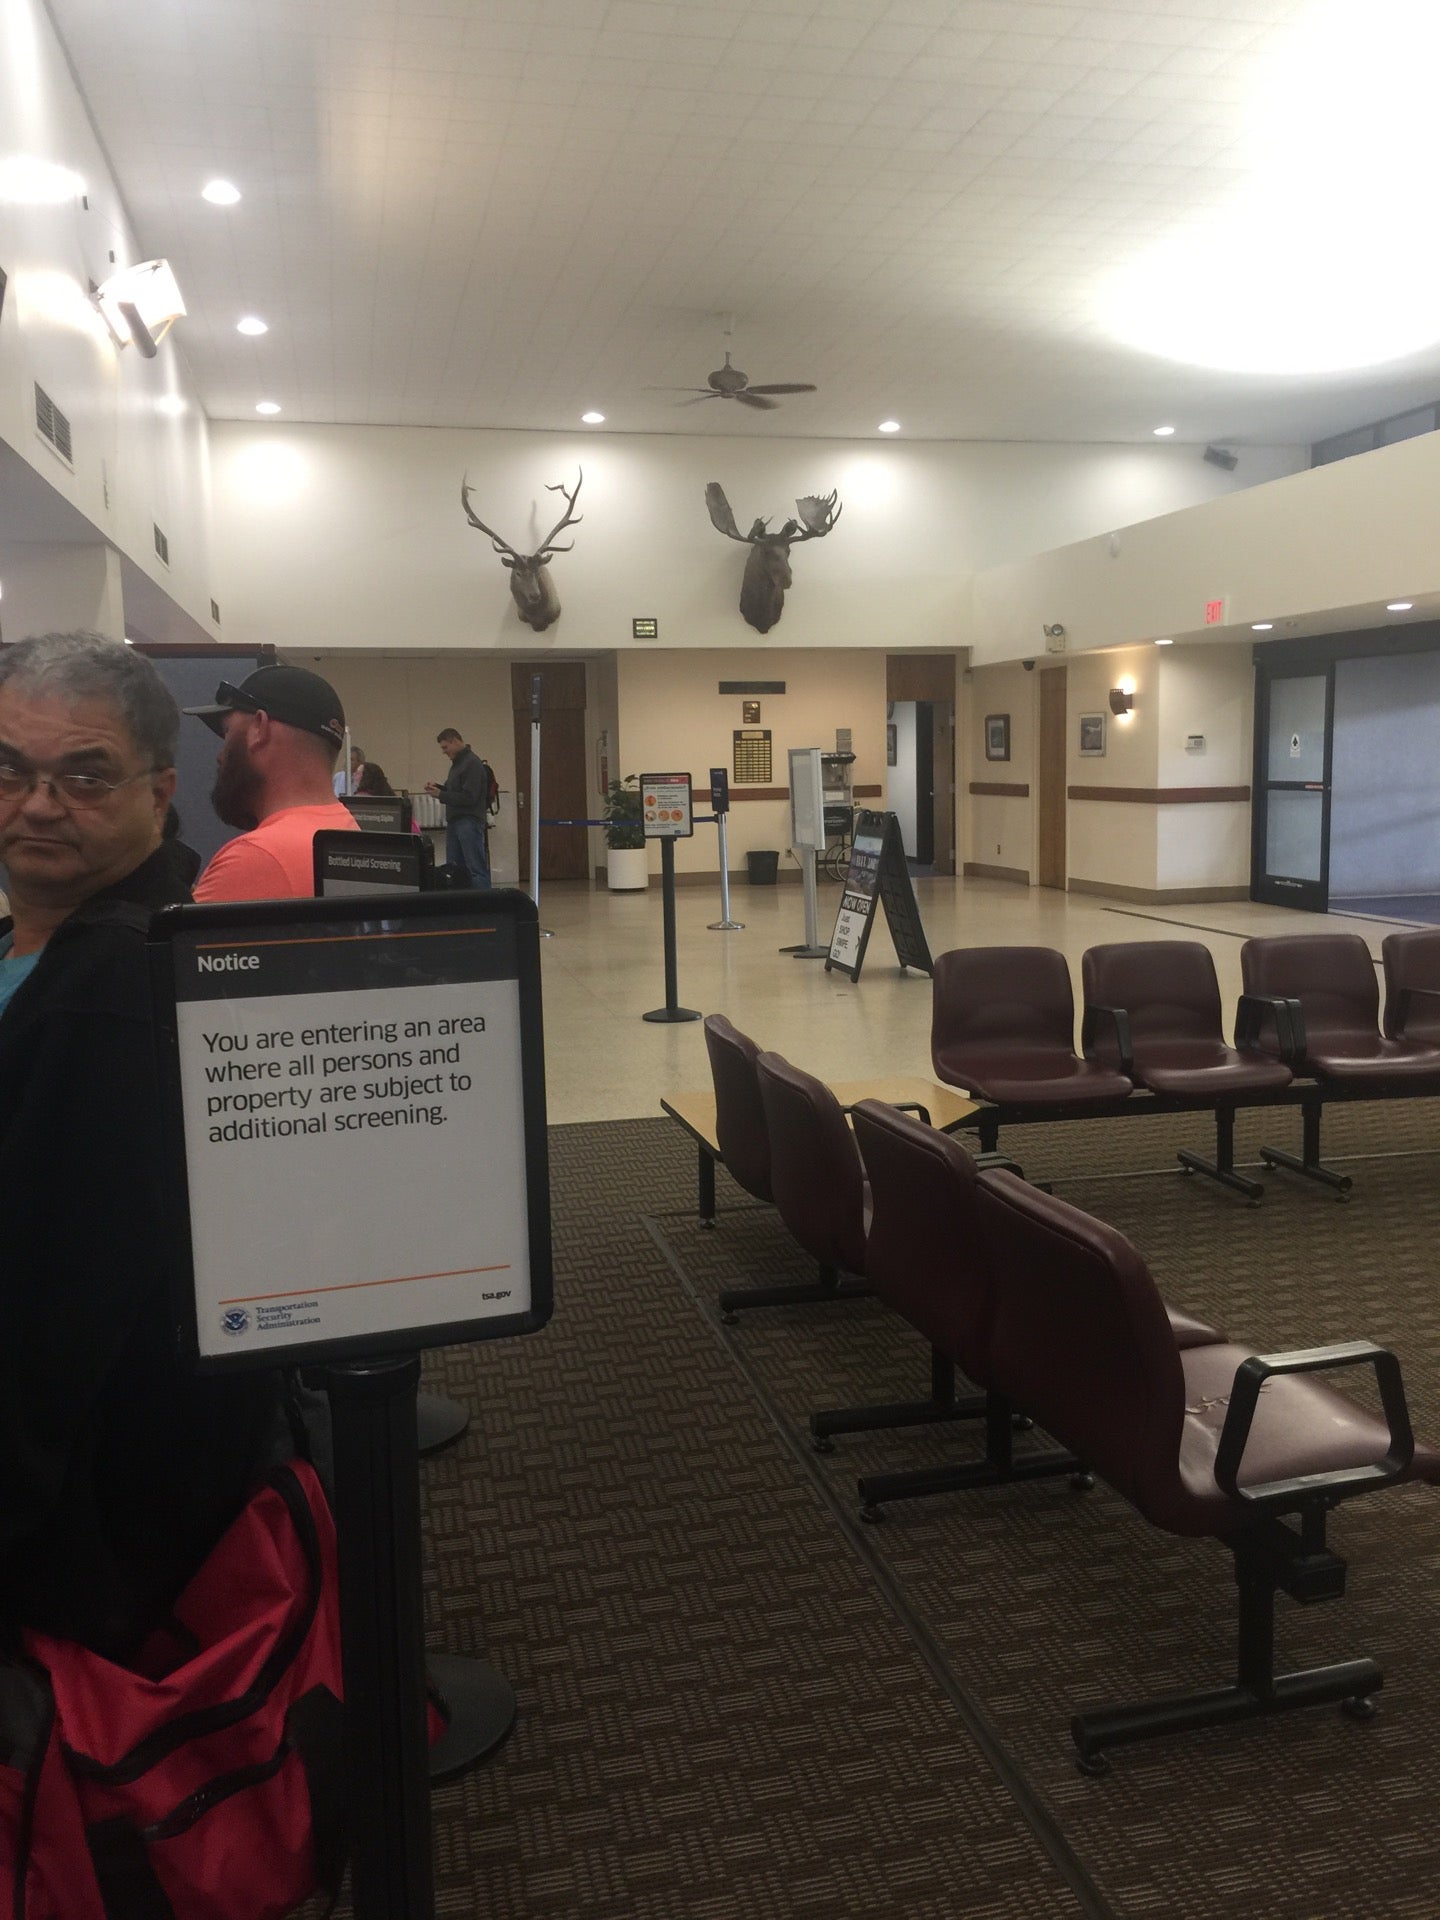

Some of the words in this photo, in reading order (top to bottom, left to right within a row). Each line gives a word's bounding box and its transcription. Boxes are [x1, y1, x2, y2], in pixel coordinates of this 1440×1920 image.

[1206, 601, 1222, 624] EXIT
[328, 855, 350, 867] Bottled
[350, 857, 369, 869] Liquid
[370, 858, 401, 872] Screening
[842, 896, 857, 910] NOW
[856, 899, 871, 914] OPEN
[197, 953, 260, 973] Notice
[202, 1032, 248, 1053] You
[256, 1030, 294, 1050] are
[301, 1020, 397, 1046] entering
[404, 1019, 431, 1038] an
[438, 1015, 486, 1035] area
[205, 1060, 281, 1083] where
[288, 1054, 315, 1077] all
[322, 1050, 413, 1077] persons
[419, 1042, 460, 1065] and
[207, 1086, 312, 1117] property
[320, 1084, 357, 1104] are
[363, 1073, 443, 1101] subject
[450, 1072, 472, 1092] to
[208, 1112, 327, 1143] additional
[334, 1104, 448, 1132] screening.
[481, 1290, 512, 1301] tsa.gov
[255, 1300, 319, 1315] Transportation
[256, 1311, 292, 1323] Security
[257, 1316, 321, 1331] Administration
